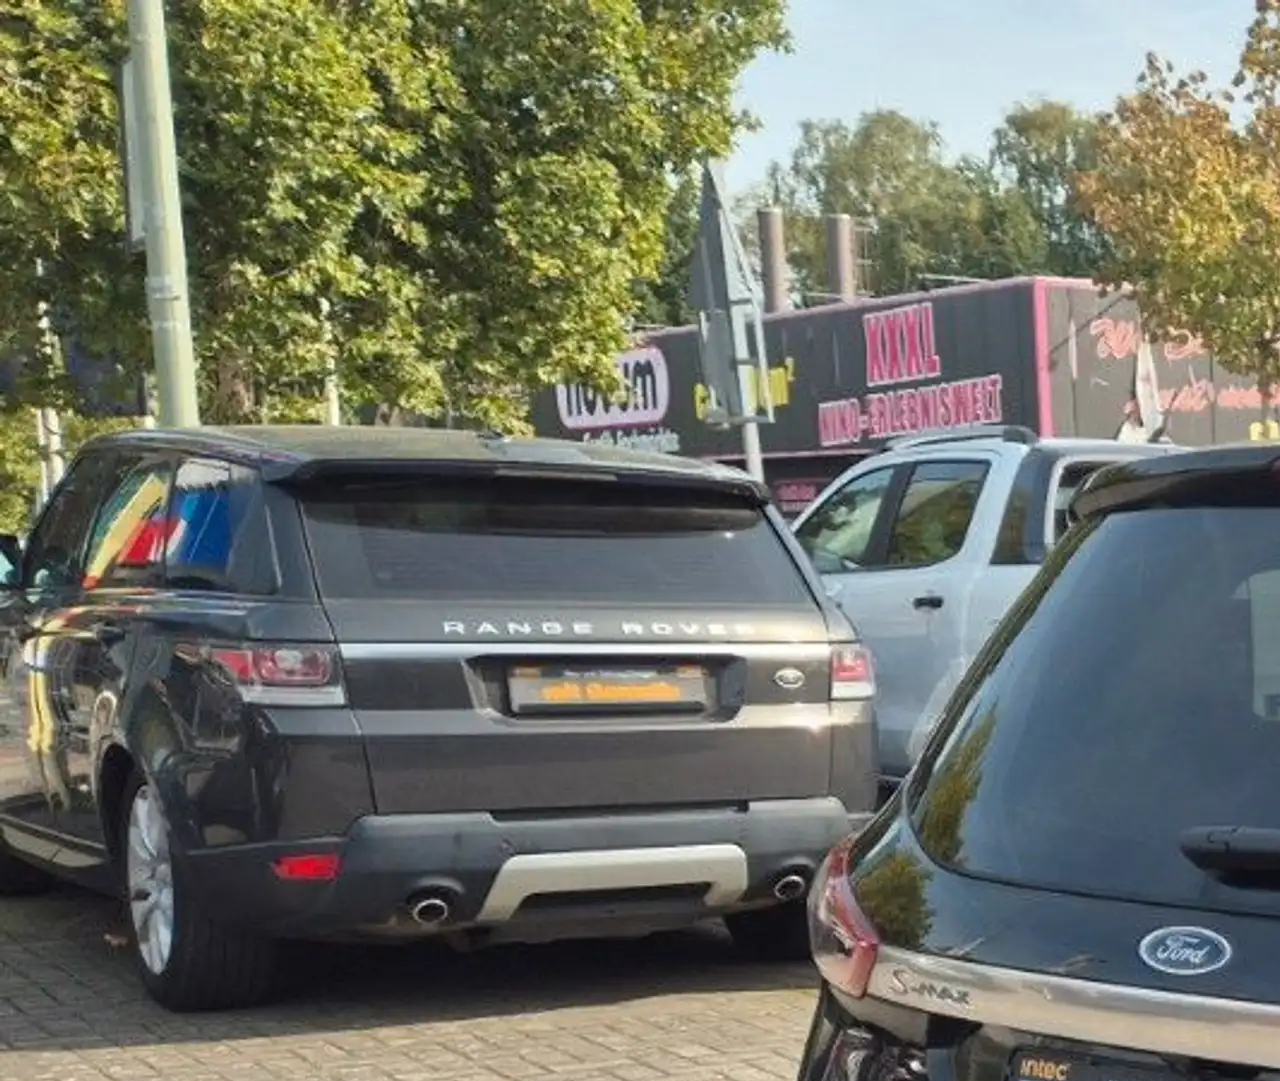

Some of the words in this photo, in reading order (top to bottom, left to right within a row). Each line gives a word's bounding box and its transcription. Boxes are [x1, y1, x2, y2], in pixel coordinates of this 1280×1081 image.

[865, 302, 941, 387] XXXL
[442, 621, 595, 636] RANGE
[621, 622, 757, 636] ROVER
[1156, 934, 1210, 965] Ford
[1020, 1058, 1069, 1081] intec
